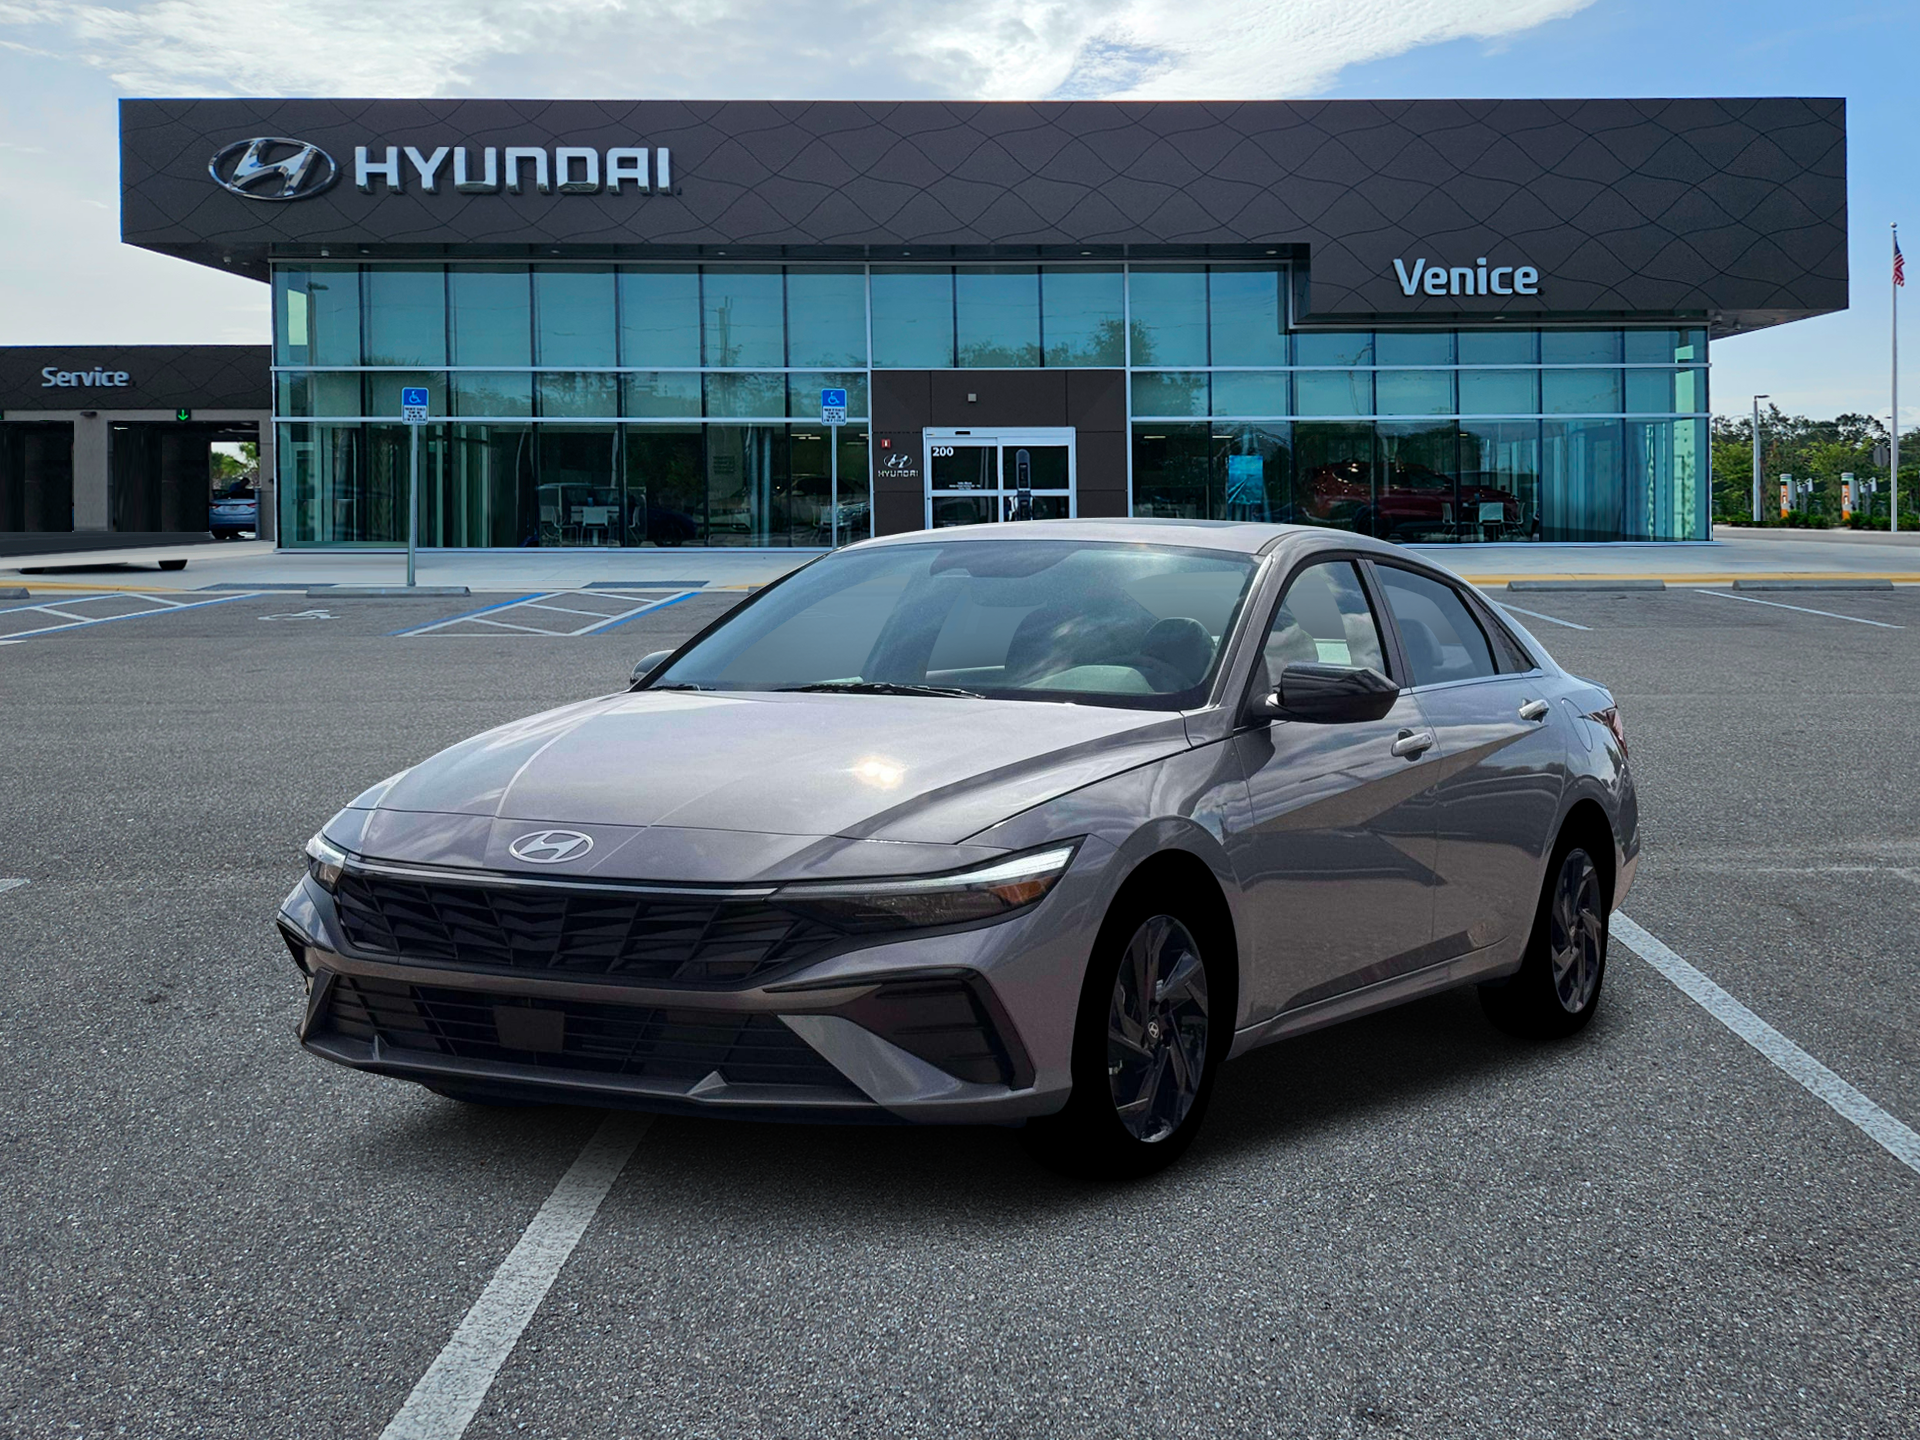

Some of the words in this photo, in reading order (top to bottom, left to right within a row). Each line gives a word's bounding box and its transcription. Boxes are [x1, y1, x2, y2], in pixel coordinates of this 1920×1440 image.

[354, 146, 671, 194] HYUNDAI
[1392, 257, 1539, 296] Venice
[41, 366, 130, 388] Service
[932, 446, 954, 457] 200
[877, 470, 919, 478] HYUNDAI
